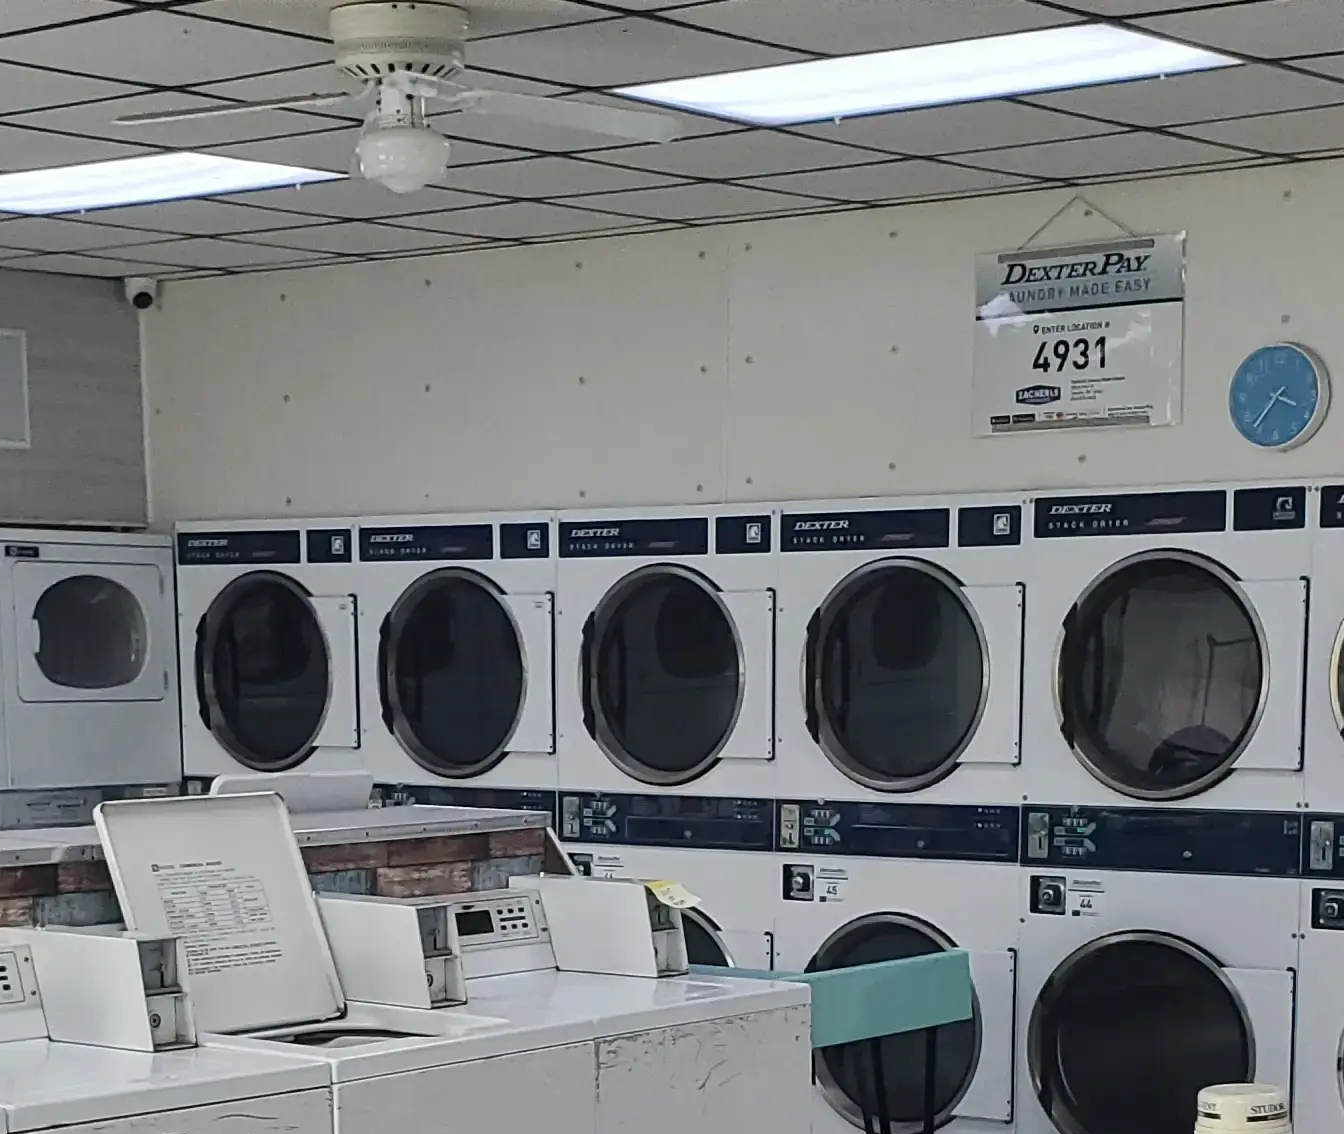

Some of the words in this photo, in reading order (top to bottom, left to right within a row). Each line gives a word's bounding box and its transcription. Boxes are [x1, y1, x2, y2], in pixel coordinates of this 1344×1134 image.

[1008, 286, 1064, 303] AUNDRY
[1069, 281, 1110, 297] MADE
[1114, 277, 1152, 294] EASY
[1041, 323, 1066, 335] ENTER
[1067, 321, 1103, 333] LOCATION
[1032, 335, 1107, 373] 4931
[1048, 503, 1113, 515] DEXTER
[793, 520, 850, 531] DEXTER
[569, 528, 620, 537] DEXTER
[1250, 1102, 1285, 1114] STUDOR
